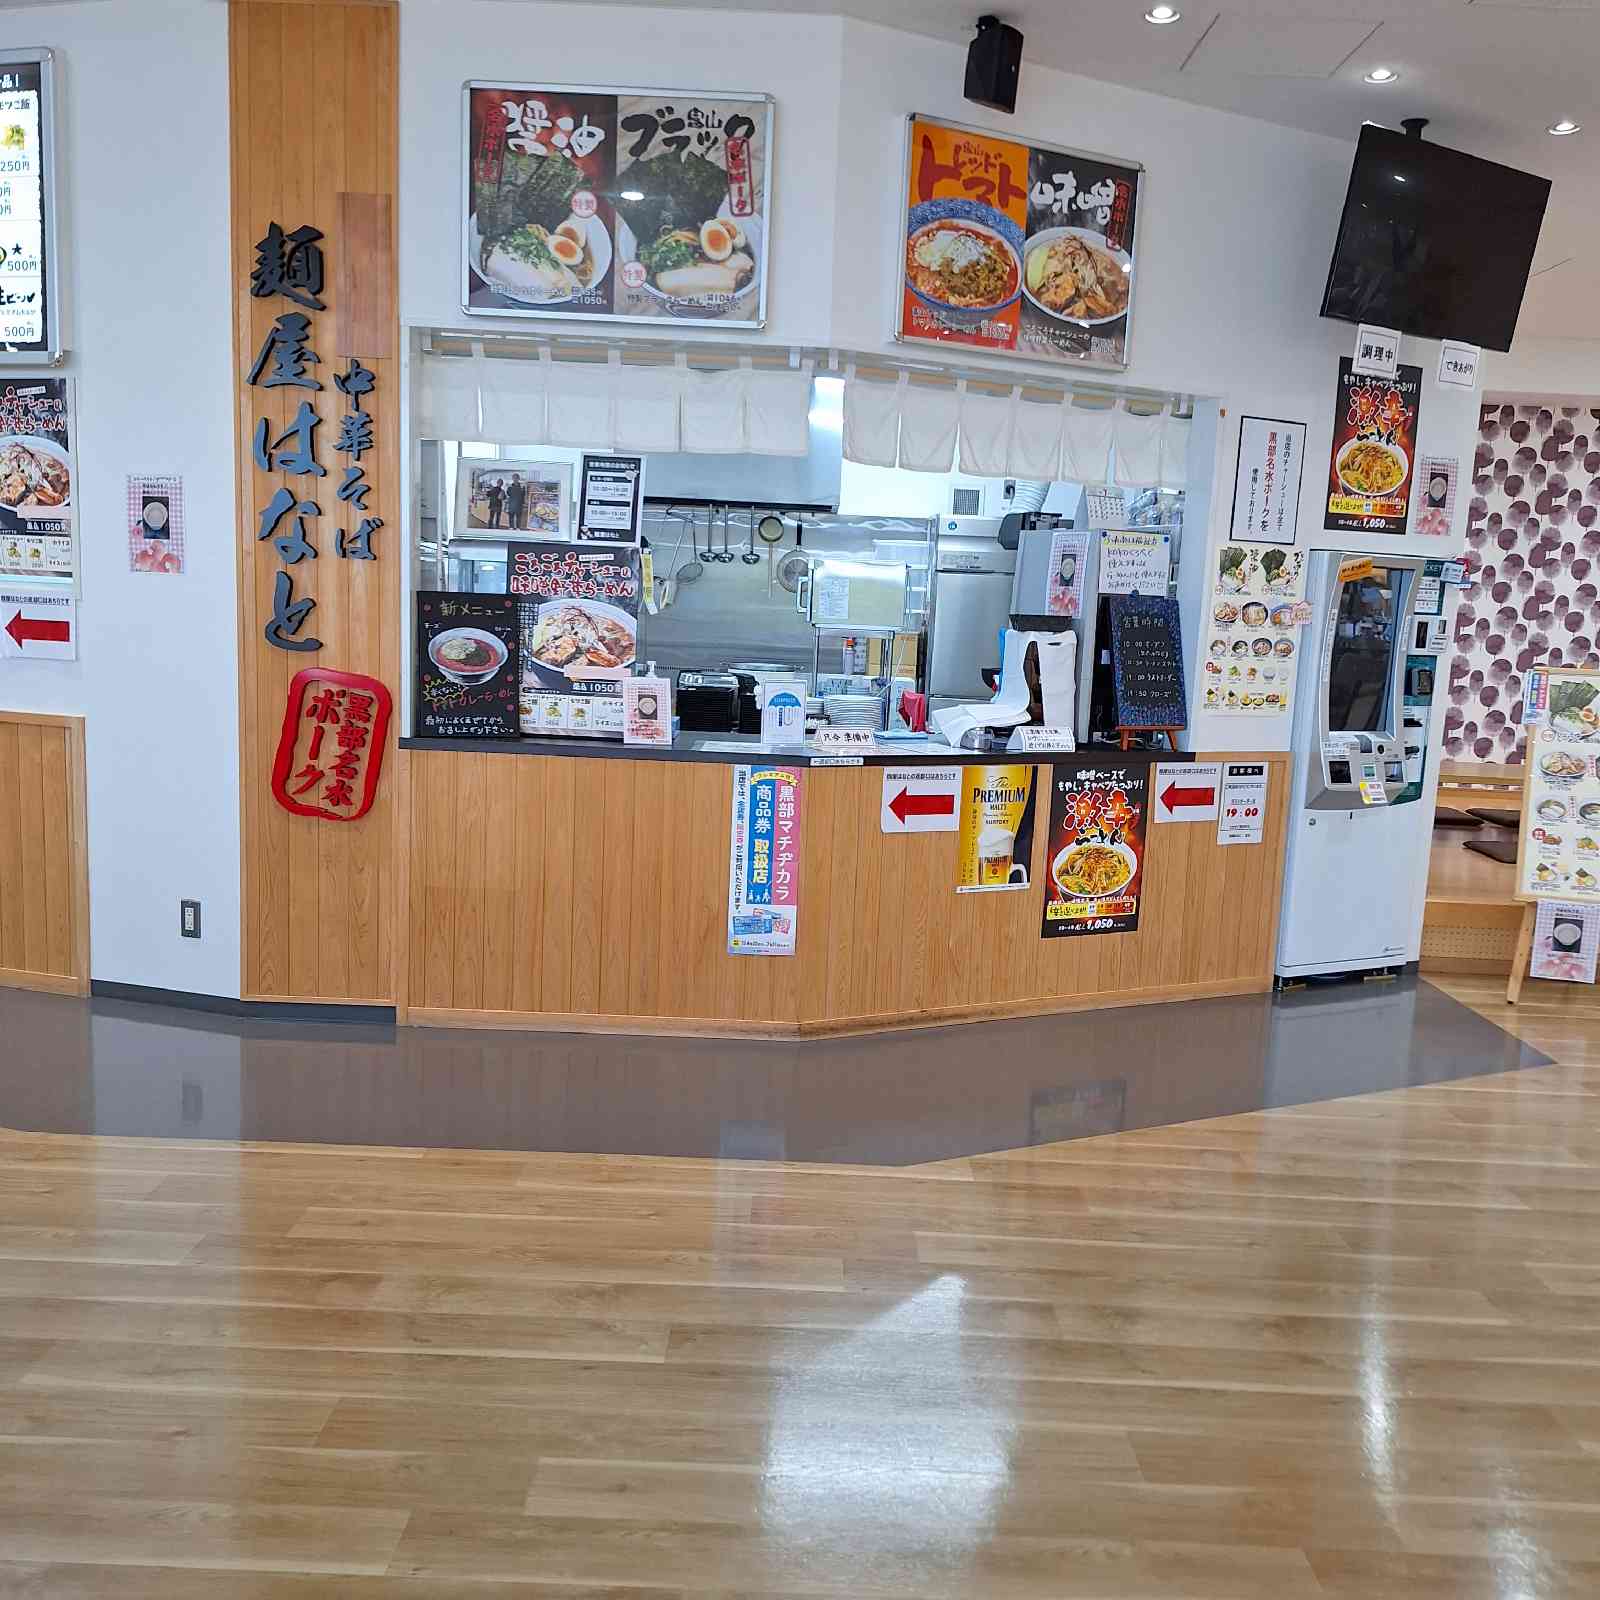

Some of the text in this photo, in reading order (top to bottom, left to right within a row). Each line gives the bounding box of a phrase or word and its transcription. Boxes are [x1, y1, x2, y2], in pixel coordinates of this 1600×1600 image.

[499, 100, 606, 158] 醤油
[917, 133, 1027, 211] トマト
[7, 260, 38, 271] 500円
[4, 326, 35, 337] 500円
[1361, 344, 1394, 361] 調理中
[1446, 360, 1475, 375] できあがり
[1347, 386, 1408, 427] 激辛
[333, 357, 386, 562] 中華そば
[1260, 431, 1278, 532] 黒部名水ポークを
[514, 551, 633, 577] ごろごろチャーシューの
[440, 600, 505, 617] 新メニュー
[292, 688, 347, 795] ポーク
[321, 691, 374, 806] 黒部名水
[972, 786, 1026, 804] PREMIUM
[1063, 789, 1134, 831] 激辛
[1226, 807, 1259, 818] 19:00
[753, 784, 772, 885] 商品券 取扱店
[775, 785, 796, 901] 黒部マチヂカラ
